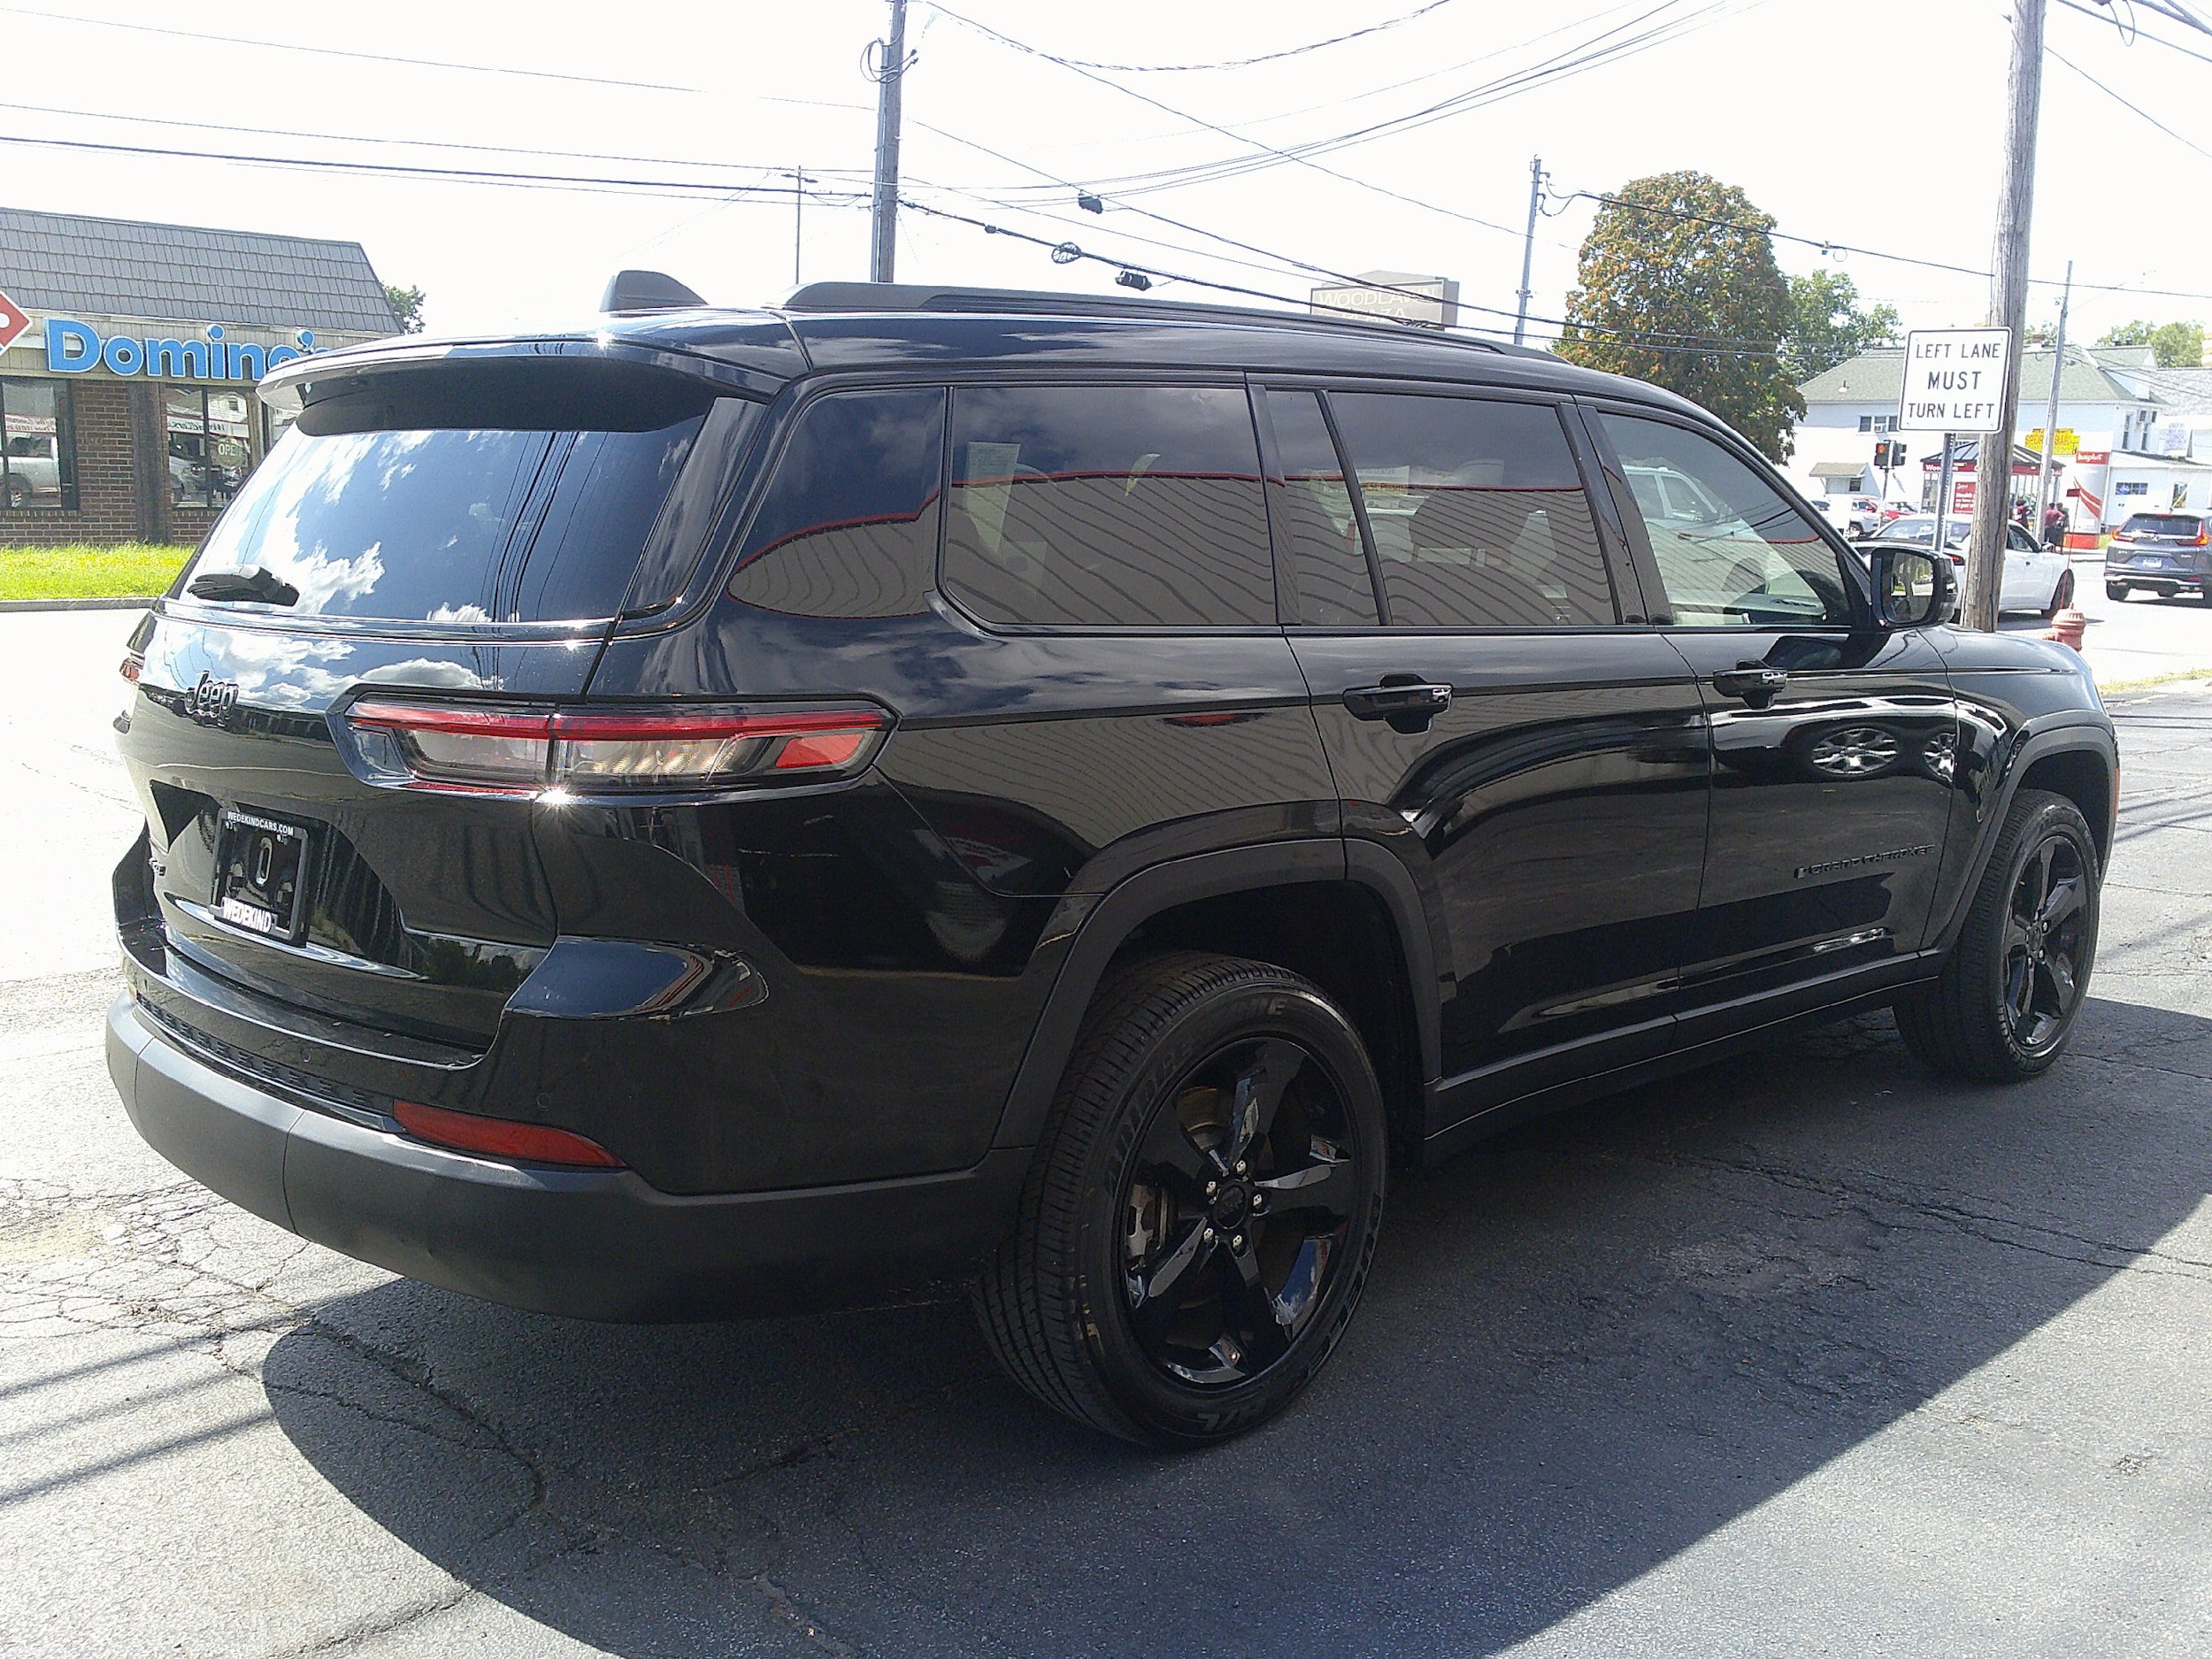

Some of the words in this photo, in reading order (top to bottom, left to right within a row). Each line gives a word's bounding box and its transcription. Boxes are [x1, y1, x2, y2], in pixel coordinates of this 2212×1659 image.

[43, 317, 329, 380] Domin'
[1916, 343, 1952, 358] LEFT
[1961, 342, 2001, 358] LANE
[1927, 371, 1982, 390] MUST
[1908, 403, 1946, 419] TURN
[1953, 403, 1995, 419] LEFT
[218, 442, 242, 457] OPE
[184, 668, 239, 727] Jeep
[227, 810, 294, 836] WEDEKINDCARS.COM
[222, 896, 272, 933] WEDEKIND
